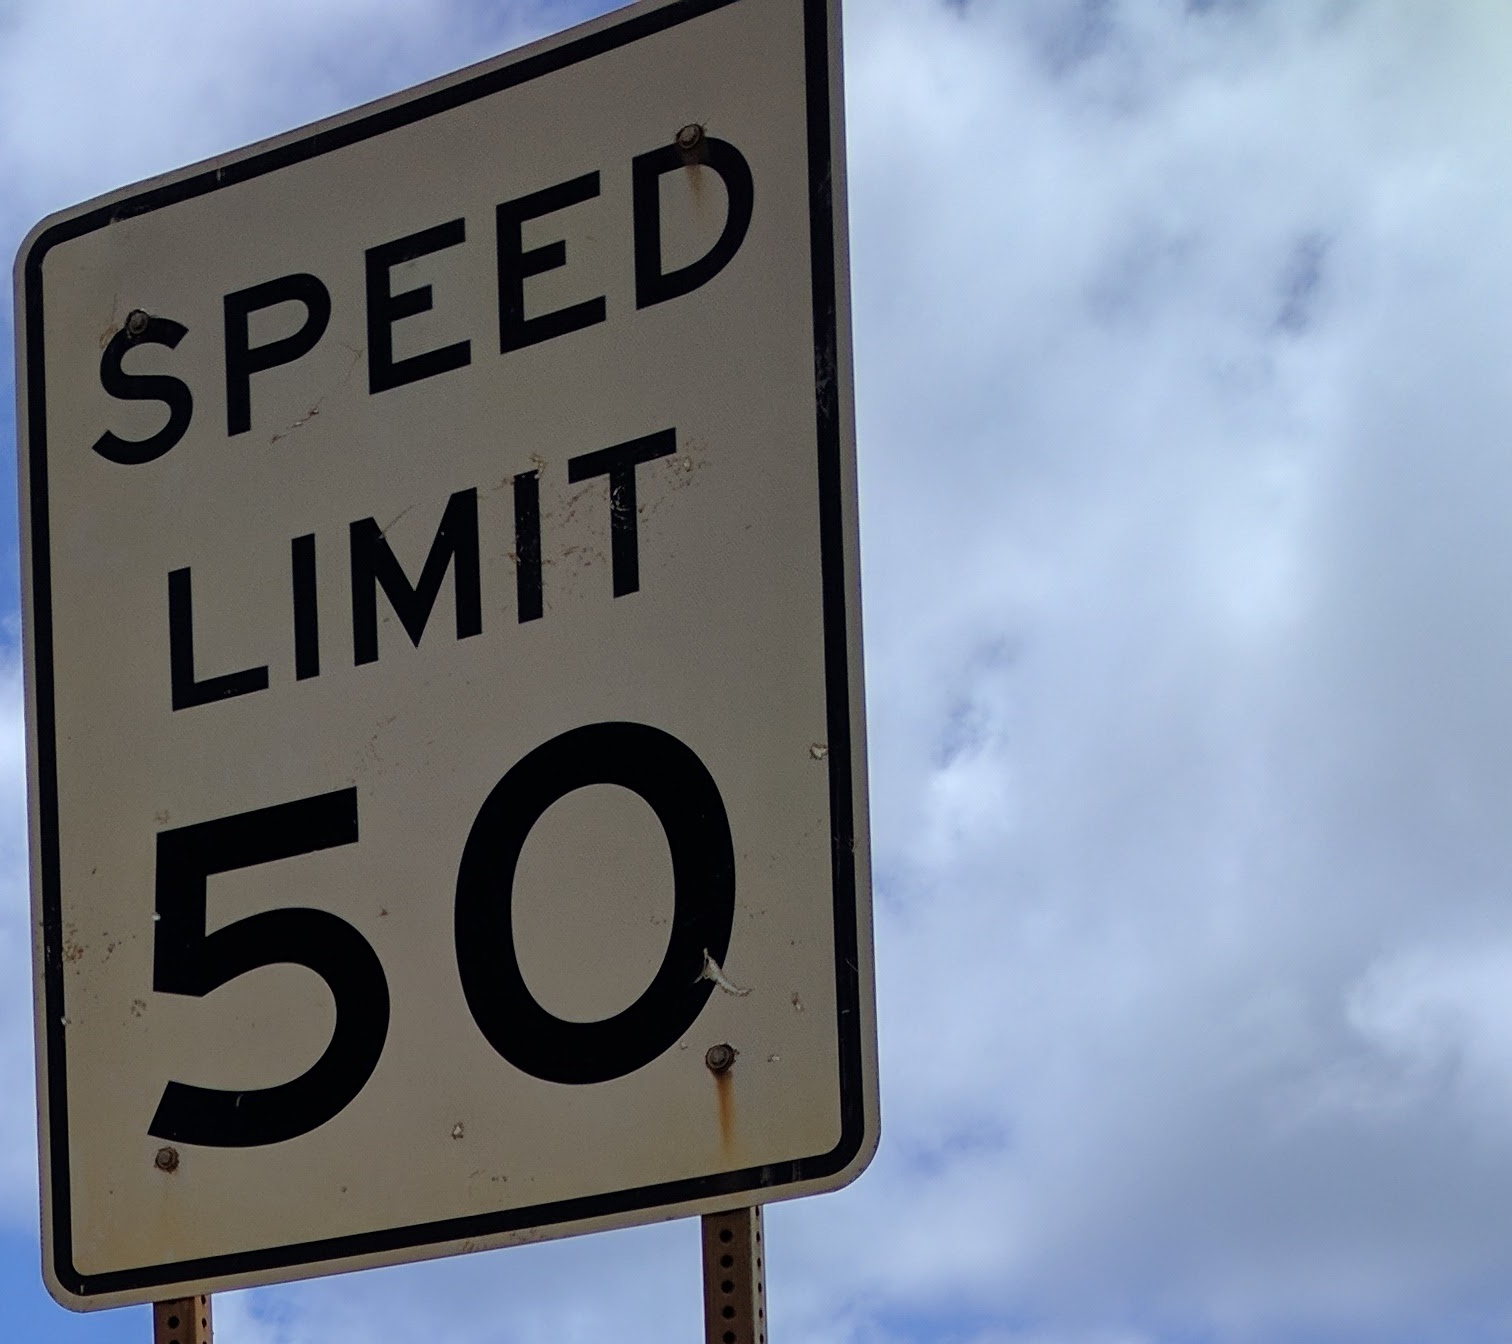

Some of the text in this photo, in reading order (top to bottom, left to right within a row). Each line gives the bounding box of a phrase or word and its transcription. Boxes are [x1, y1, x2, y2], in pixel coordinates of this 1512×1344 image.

[92, 134, 755, 466] SPEED
[167, 428, 677, 712] LIMIT
[147, 721, 736, 1148] 50
